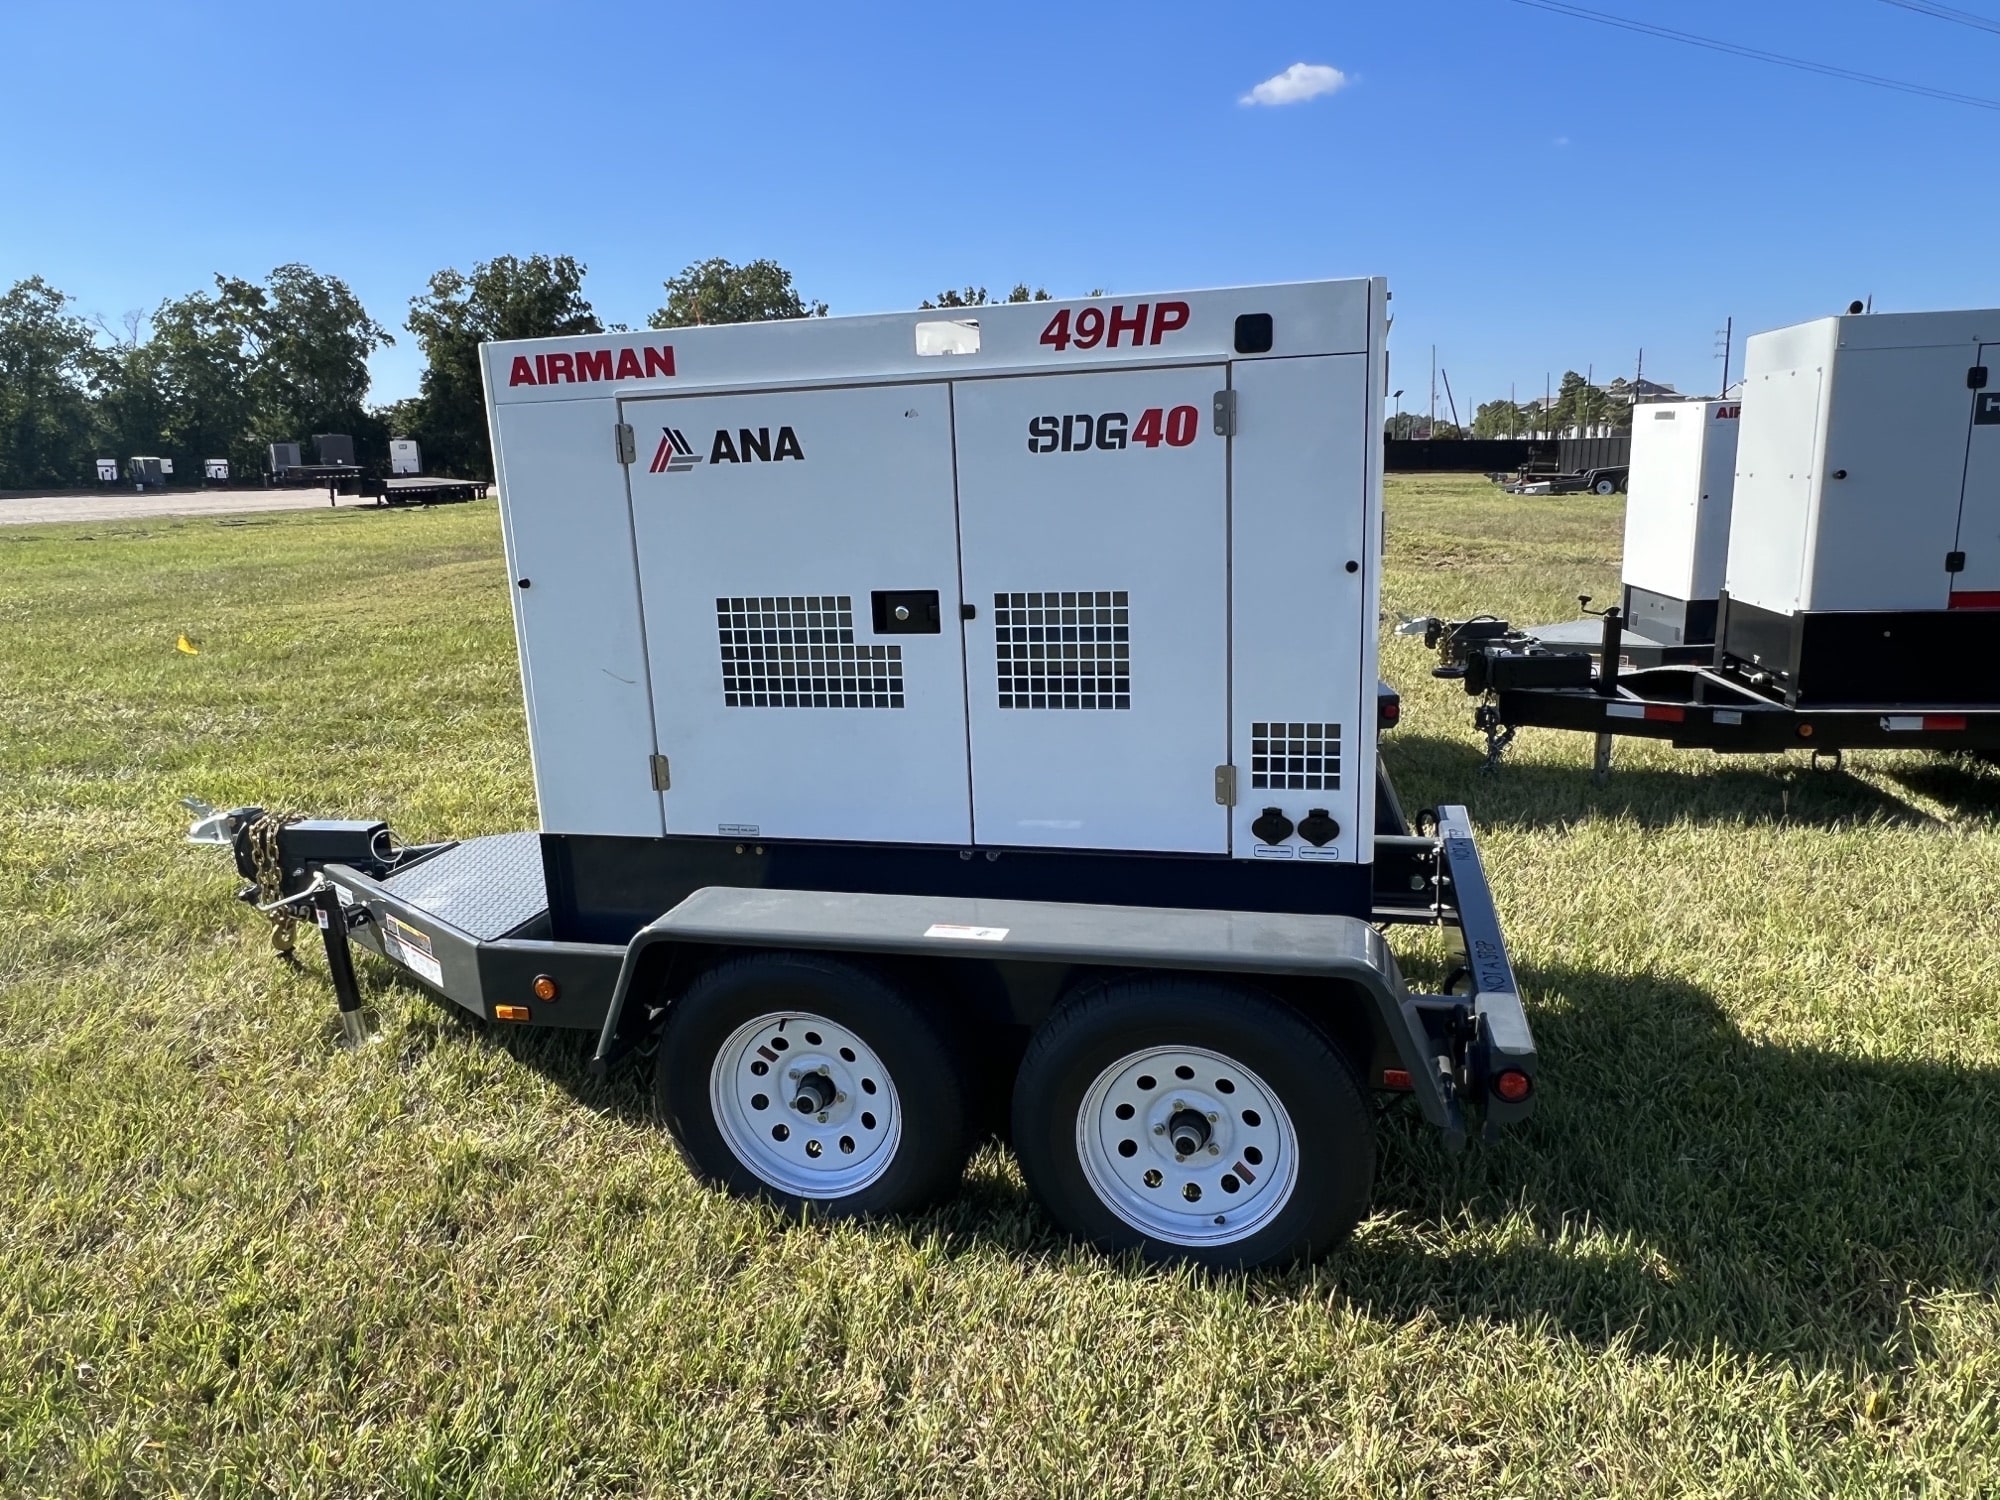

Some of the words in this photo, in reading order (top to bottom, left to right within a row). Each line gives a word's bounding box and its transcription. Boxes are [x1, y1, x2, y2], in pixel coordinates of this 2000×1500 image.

[1039, 301, 1191, 351] 49HP
[508, 346, 676, 387] AIRMAN
[709, 426, 806, 465] ANA
[1475, 940, 1499, 960] STEP
[1482, 971, 1507, 993] NOT
